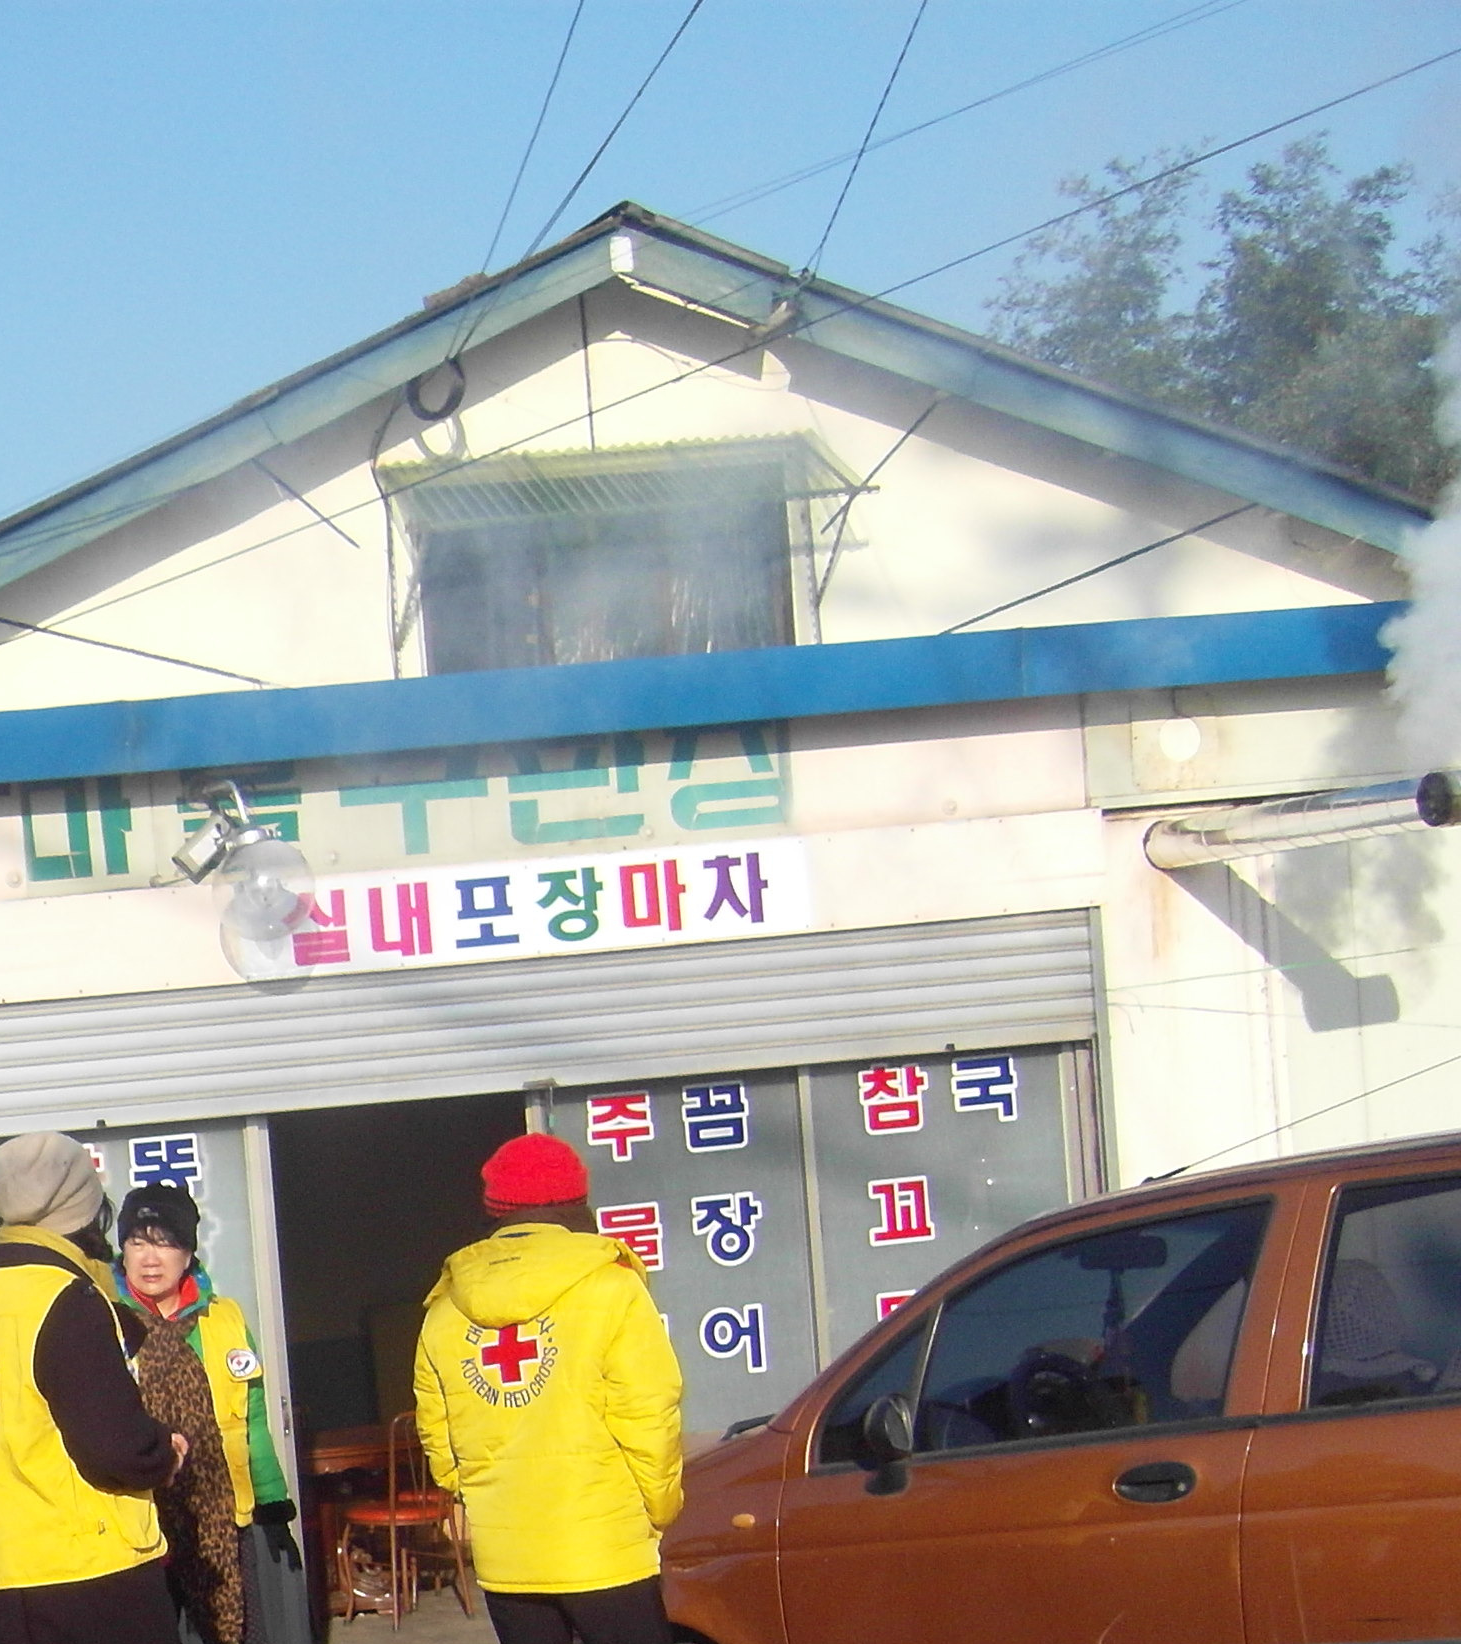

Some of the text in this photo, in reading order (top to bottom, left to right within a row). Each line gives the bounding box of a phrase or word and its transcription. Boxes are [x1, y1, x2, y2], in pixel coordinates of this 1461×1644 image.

[283, 853, 769, 967] 실내포장마차
[682, 1081, 767, 1373] 꼼장어
[858, 1064, 936, 1320] 참꼬
[460, 1346, 559, 1408] KOREAN RED CROSS
